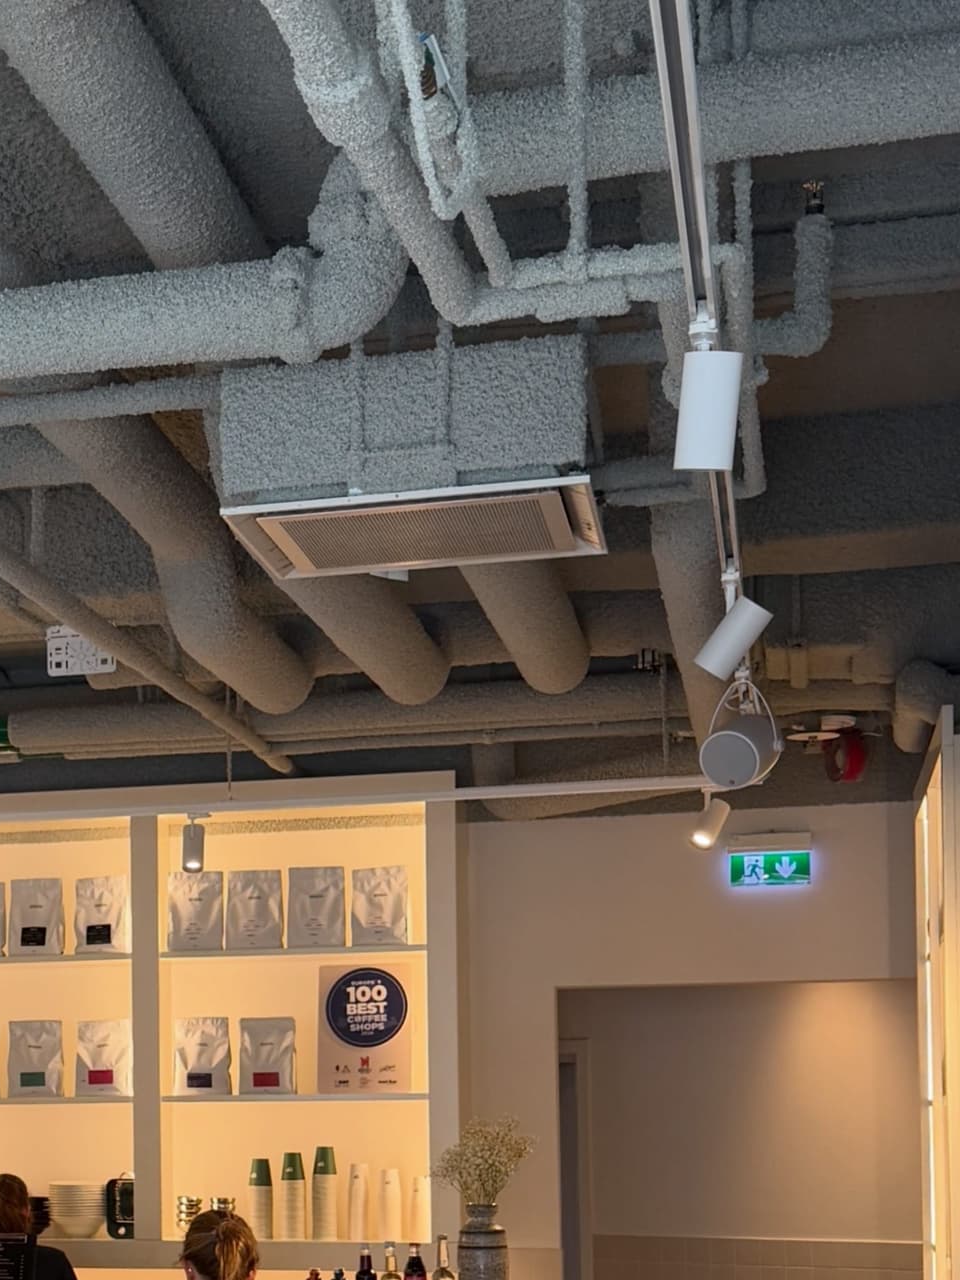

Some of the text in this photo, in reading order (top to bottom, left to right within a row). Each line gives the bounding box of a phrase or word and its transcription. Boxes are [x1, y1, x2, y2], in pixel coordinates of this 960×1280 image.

[346, 985, 387, 1002] 100
[346, 1002, 388, 1015] BEST
[347, 1014, 387, 1023] COFFEE
[350, 1023, 384, 1031] SHOPS
